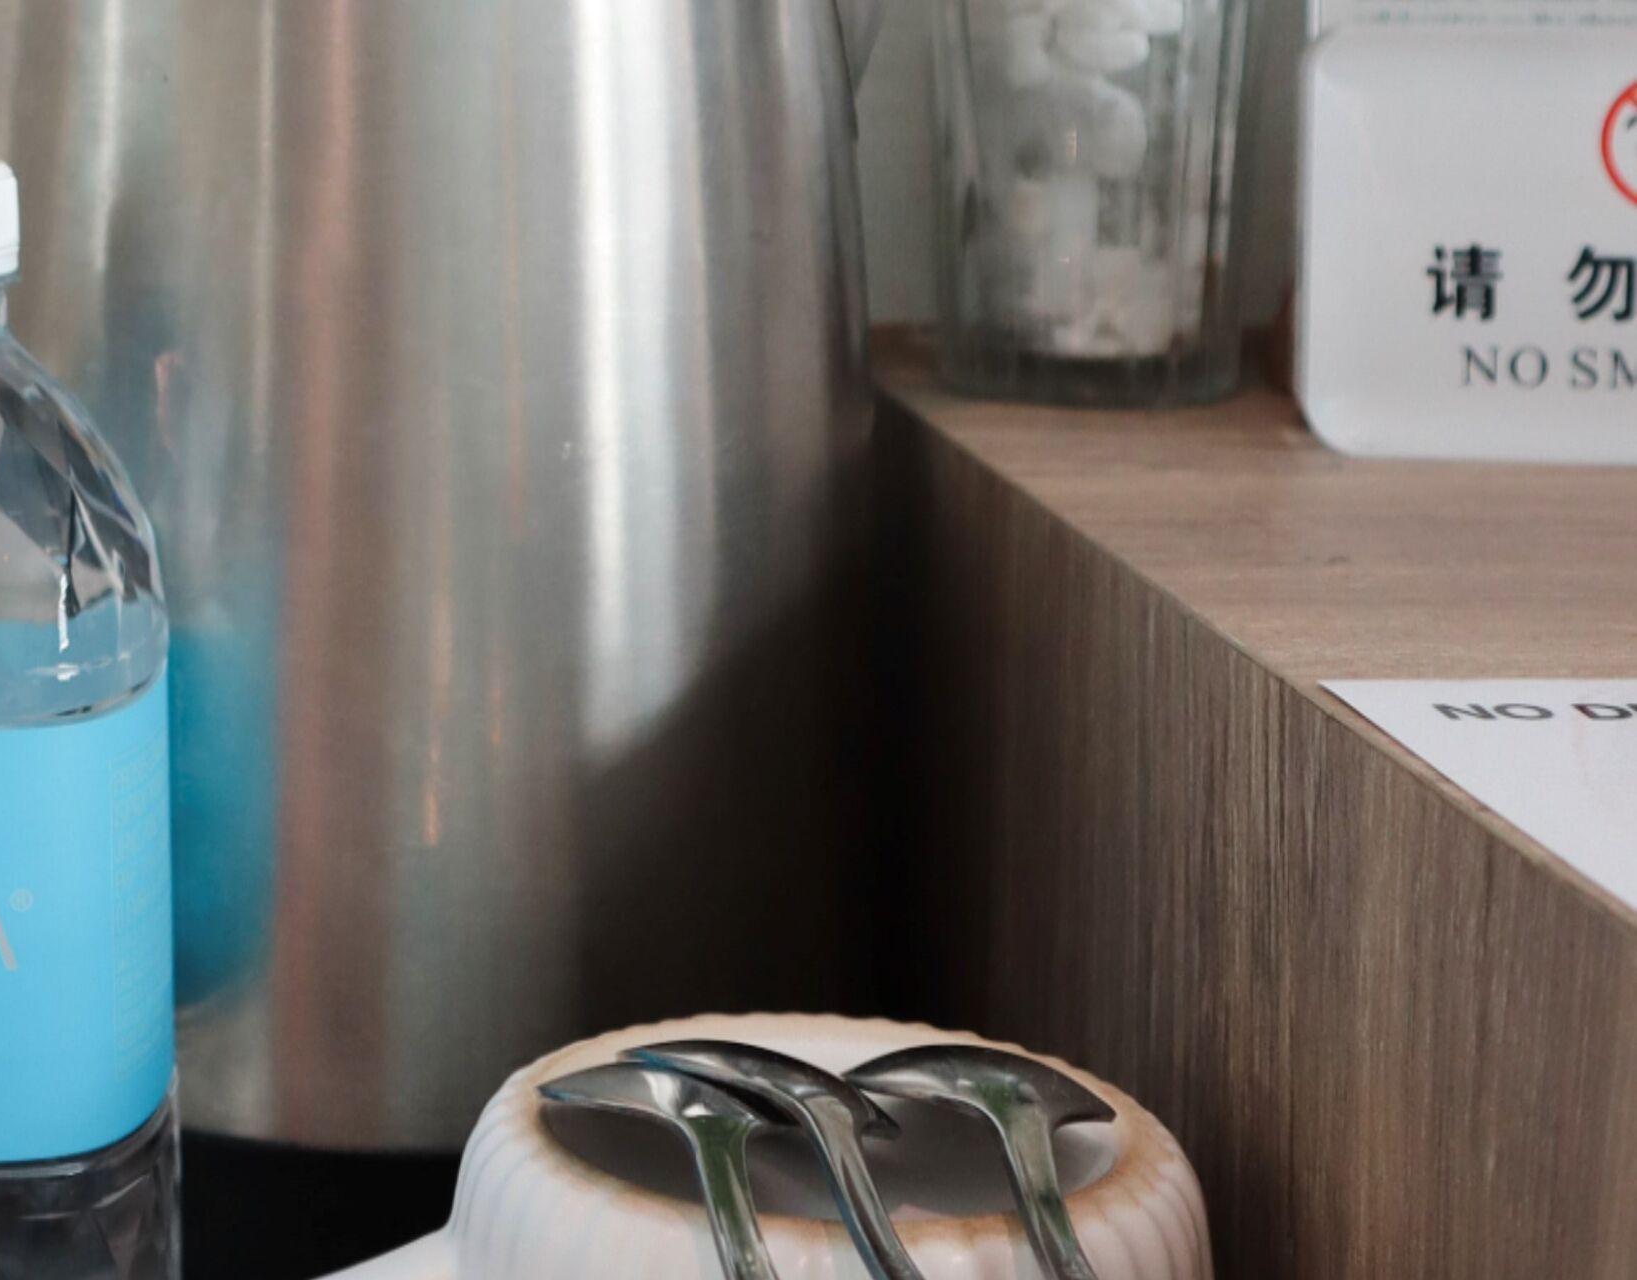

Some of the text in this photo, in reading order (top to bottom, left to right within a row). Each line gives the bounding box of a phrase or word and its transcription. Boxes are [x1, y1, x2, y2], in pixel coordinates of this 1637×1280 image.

[1460, 344, 1550, 390] NO
[1432, 703, 1637, 721] NO D
